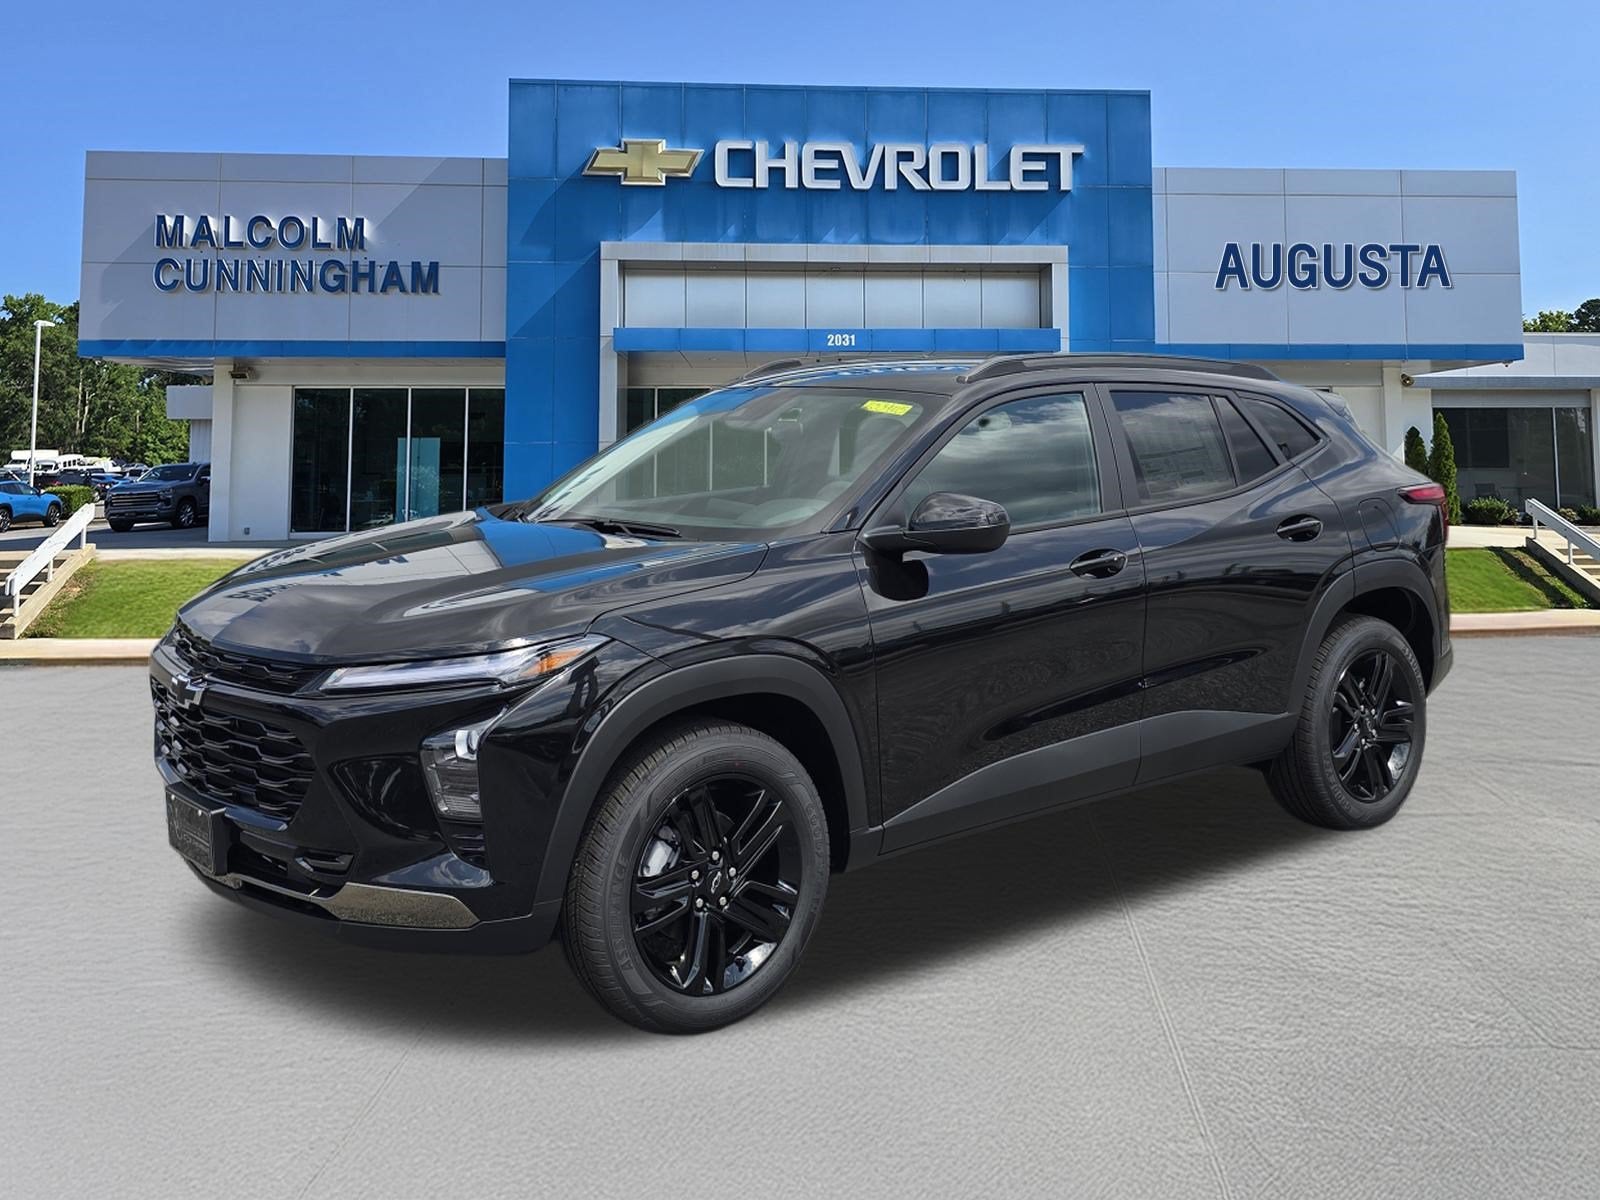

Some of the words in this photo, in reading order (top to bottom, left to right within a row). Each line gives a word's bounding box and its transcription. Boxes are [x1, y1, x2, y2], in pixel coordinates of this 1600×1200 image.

[714, 139, 1085, 192] CHEVROLET
[154, 213, 367, 251] MALCOLM
[152, 257, 441, 295] CUNNINGHAM
[1214, 242, 1452, 290] AUGUSTA
[826, 333, 856, 347] 2031
